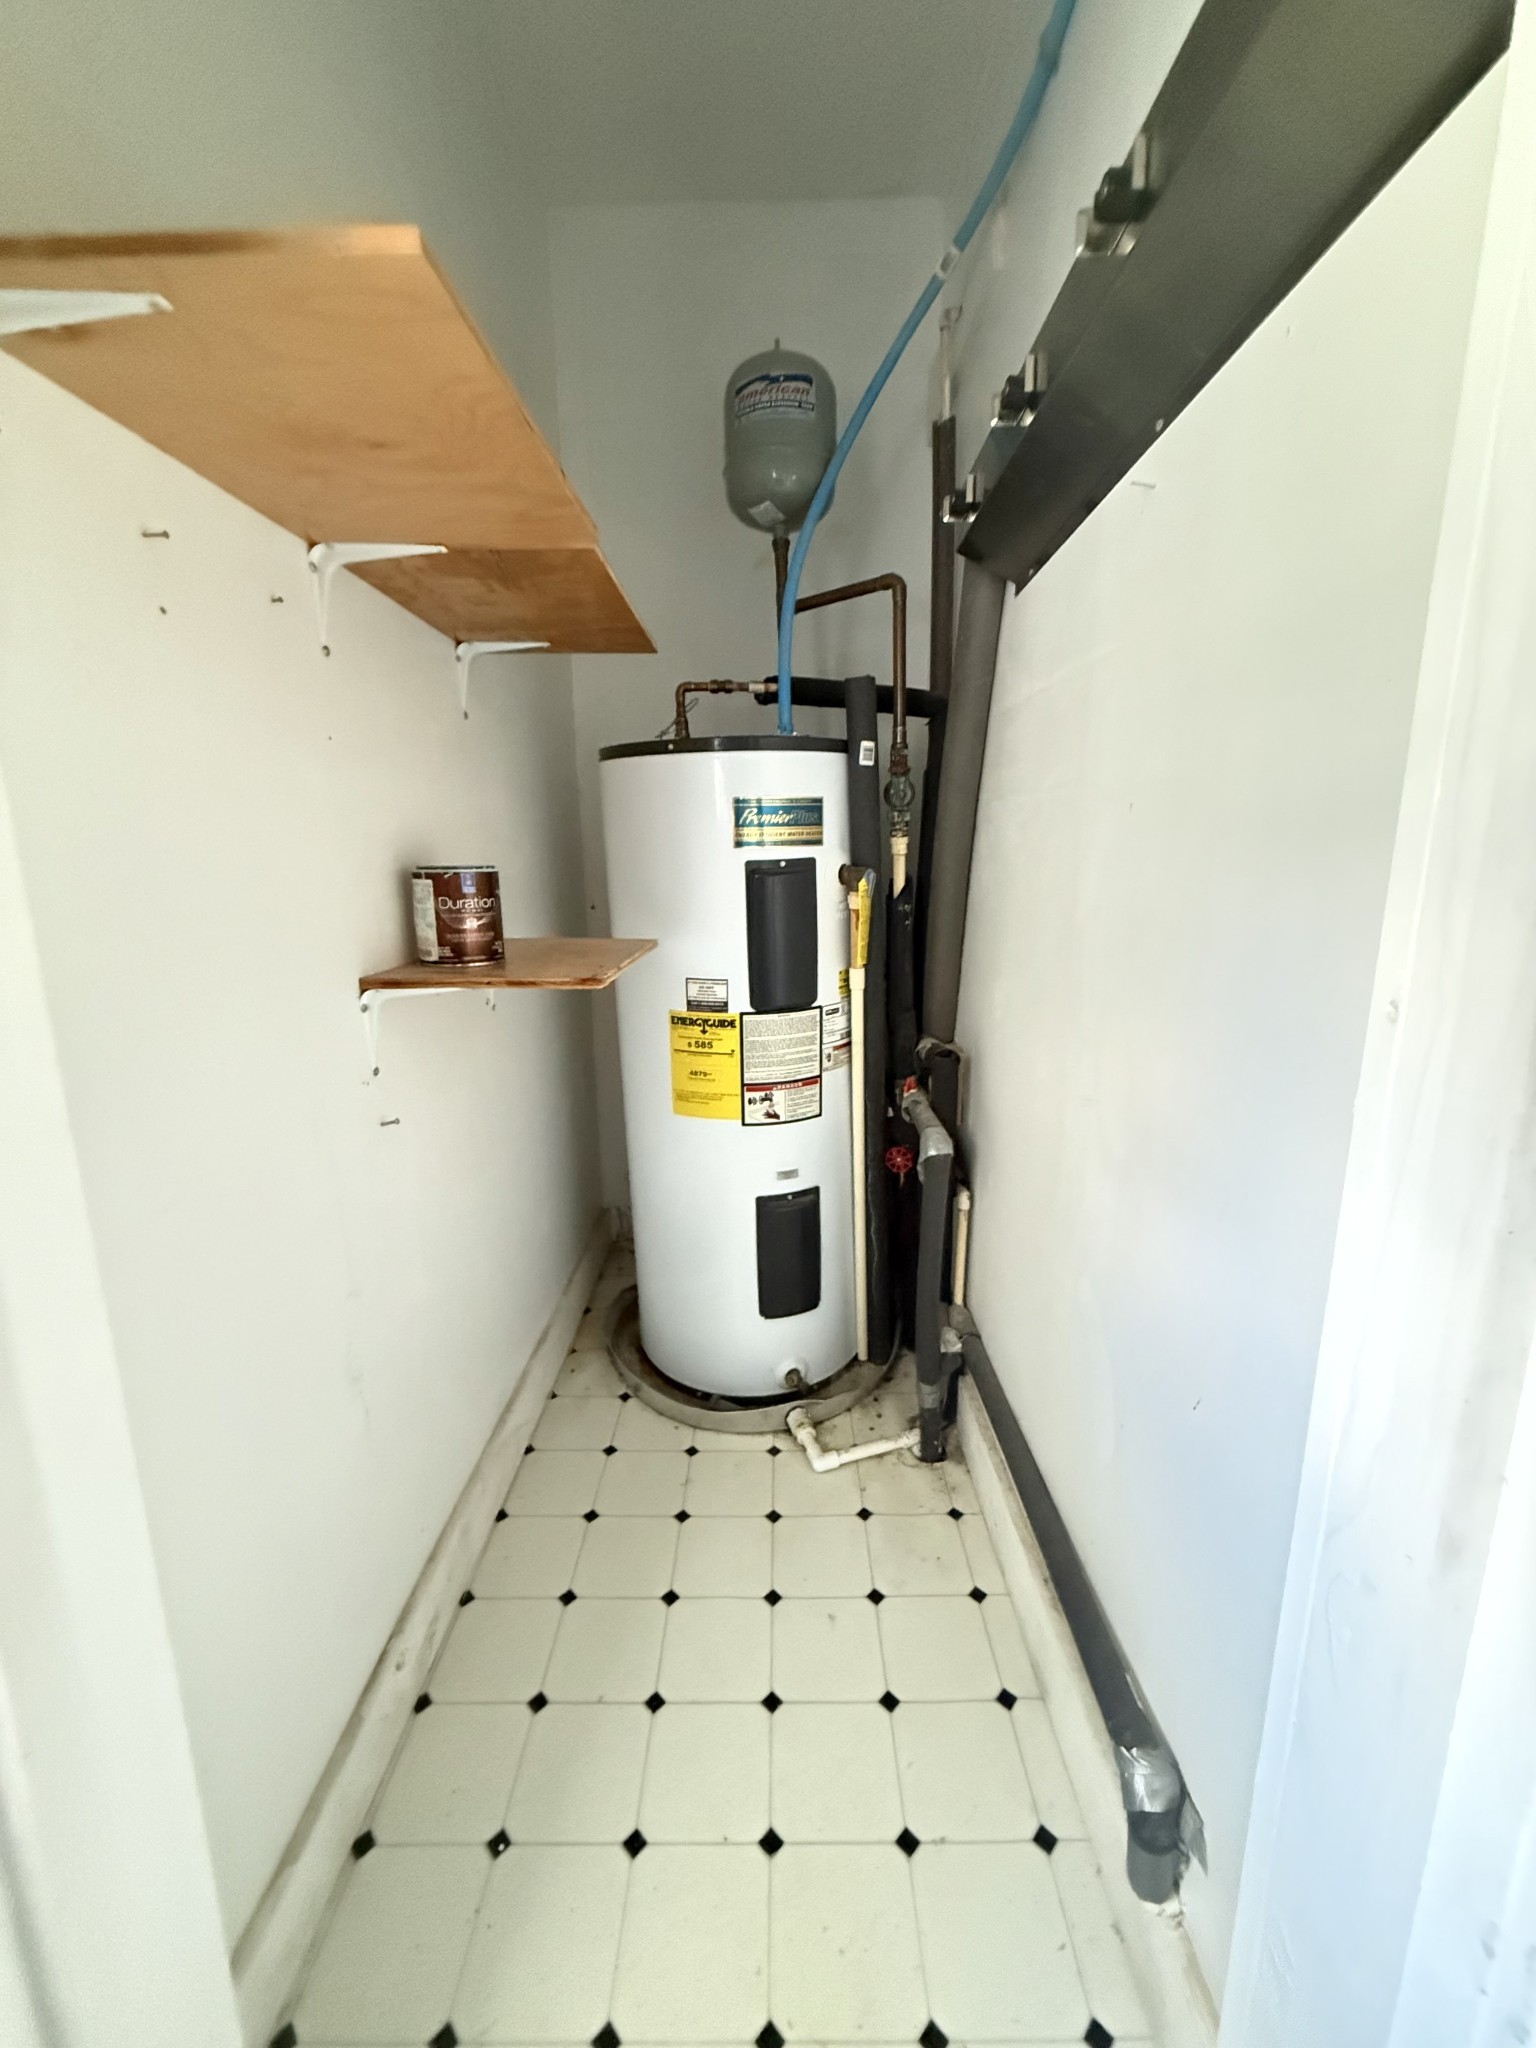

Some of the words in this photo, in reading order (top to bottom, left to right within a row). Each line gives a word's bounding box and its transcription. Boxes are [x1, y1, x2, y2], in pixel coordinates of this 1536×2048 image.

[738, 807, 797, 825] Premier
[438, 895, 496, 910] Duration
[671, 1015, 737, 1029] ENERGYGUIDE
[694, 1041, 713, 1049] 585
